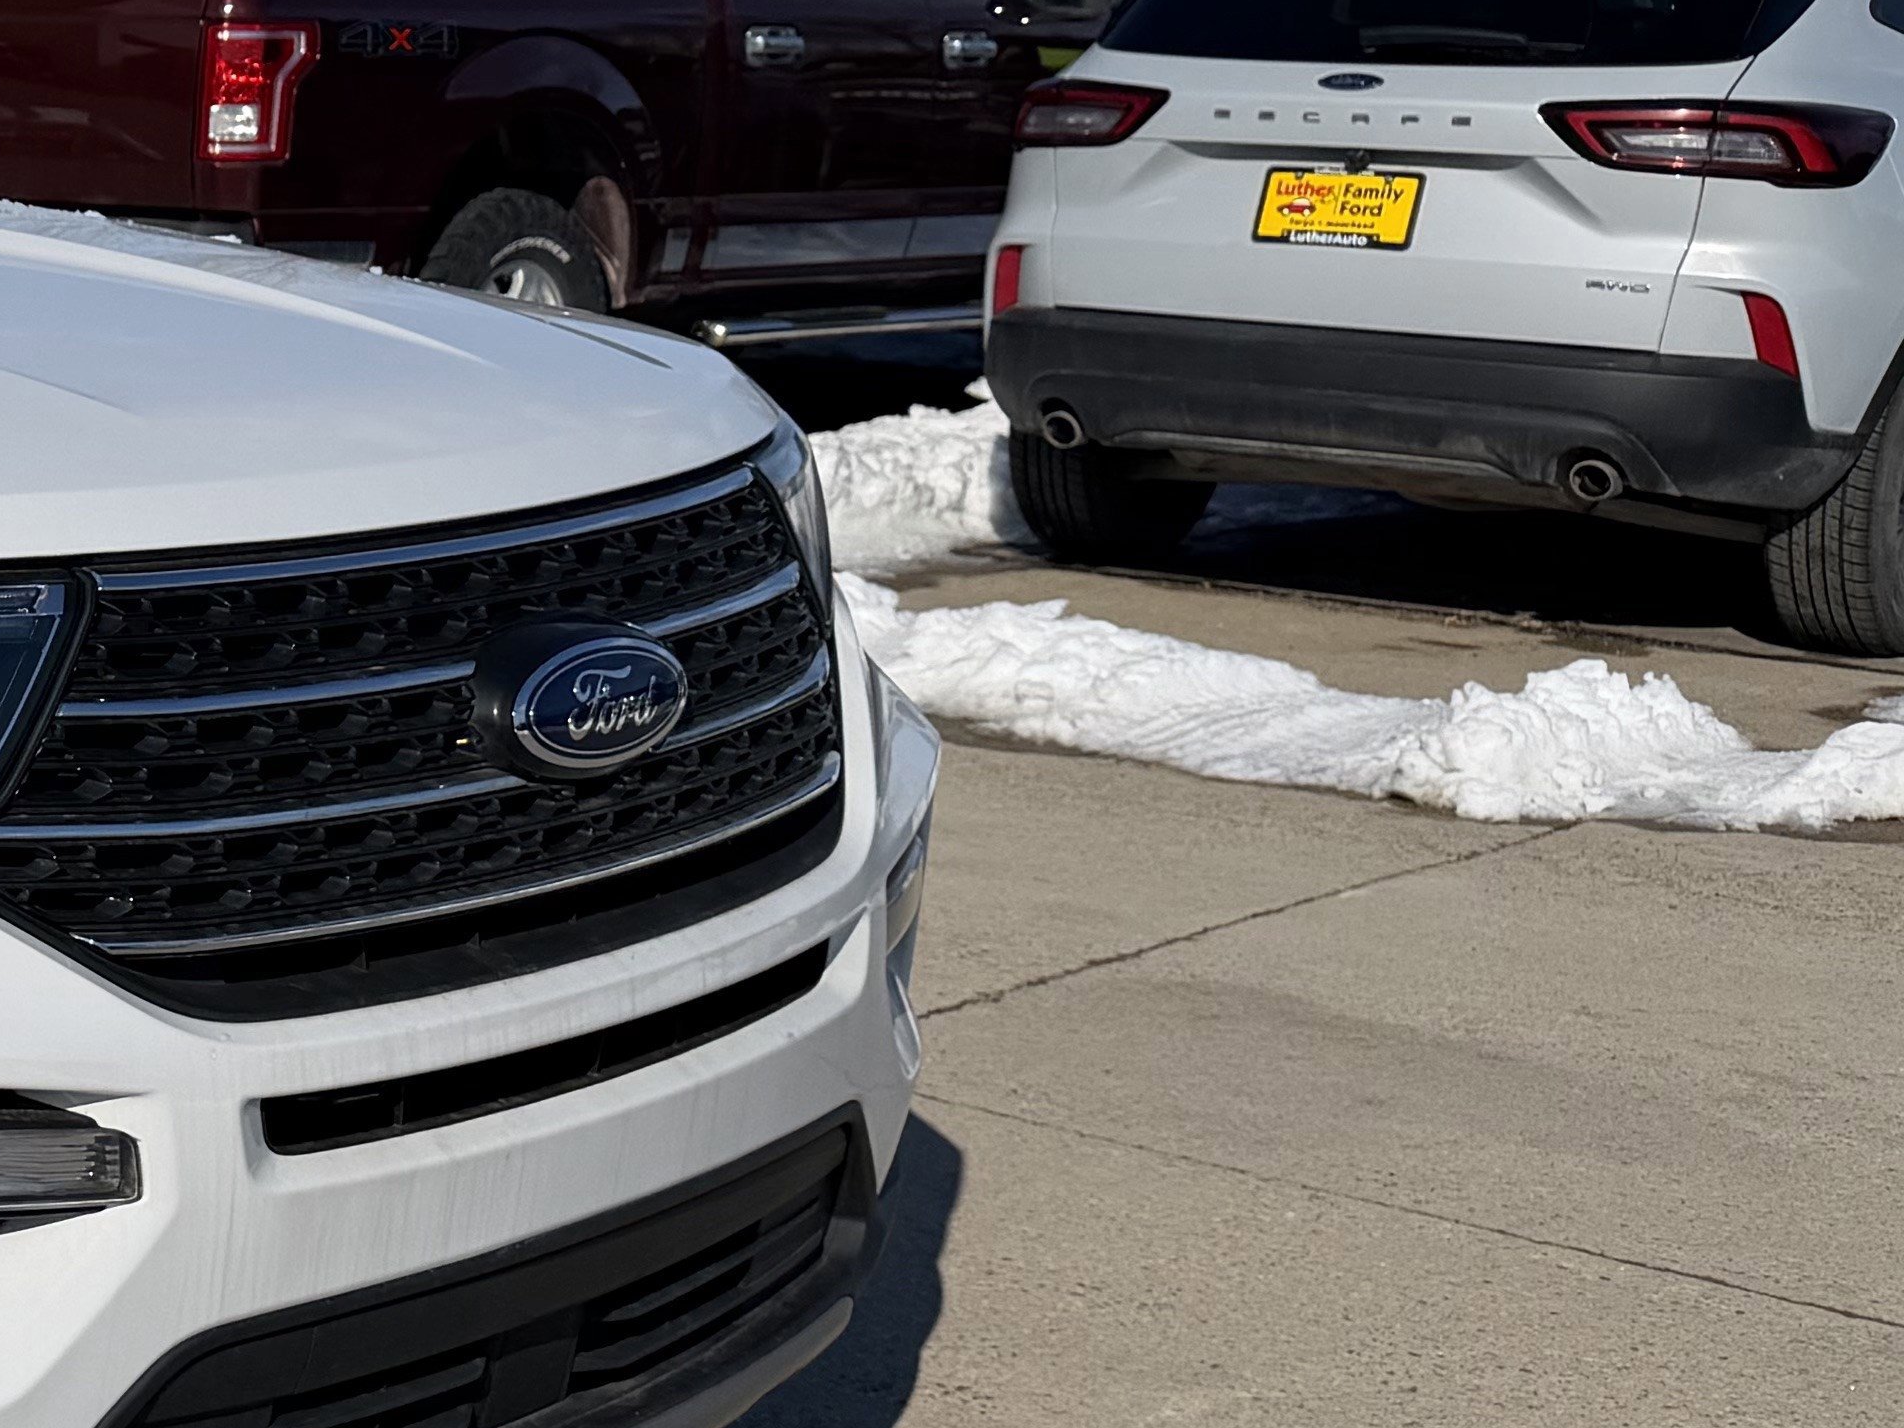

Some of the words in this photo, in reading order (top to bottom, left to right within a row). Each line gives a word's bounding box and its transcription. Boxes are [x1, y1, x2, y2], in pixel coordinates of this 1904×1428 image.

[1213, 108, 1472, 127] ESCAPE
[1276, 179, 1334, 198] Luther
[1343, 183, 1404, 205] Family
[1339, 200, 1383, 217] Ford
[567, 665, 659, 741] Ford
